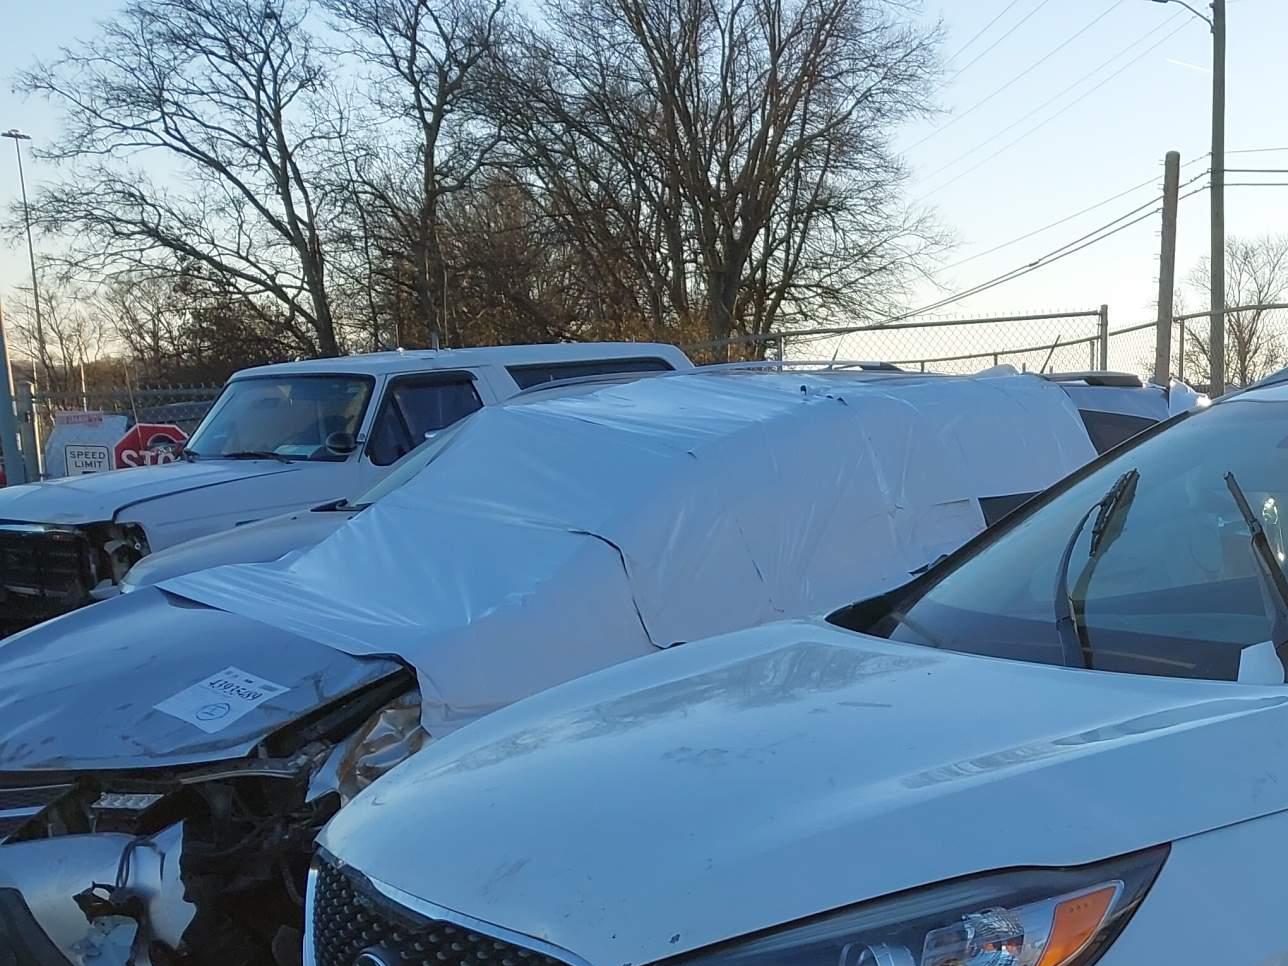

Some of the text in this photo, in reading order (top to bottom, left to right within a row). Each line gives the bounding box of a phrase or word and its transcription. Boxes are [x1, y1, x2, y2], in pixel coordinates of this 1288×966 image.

[69, 451, 106, 460] SPEED
[121, 449, 180, 467] STO
[74, 460, 103, 469] LIMIT
